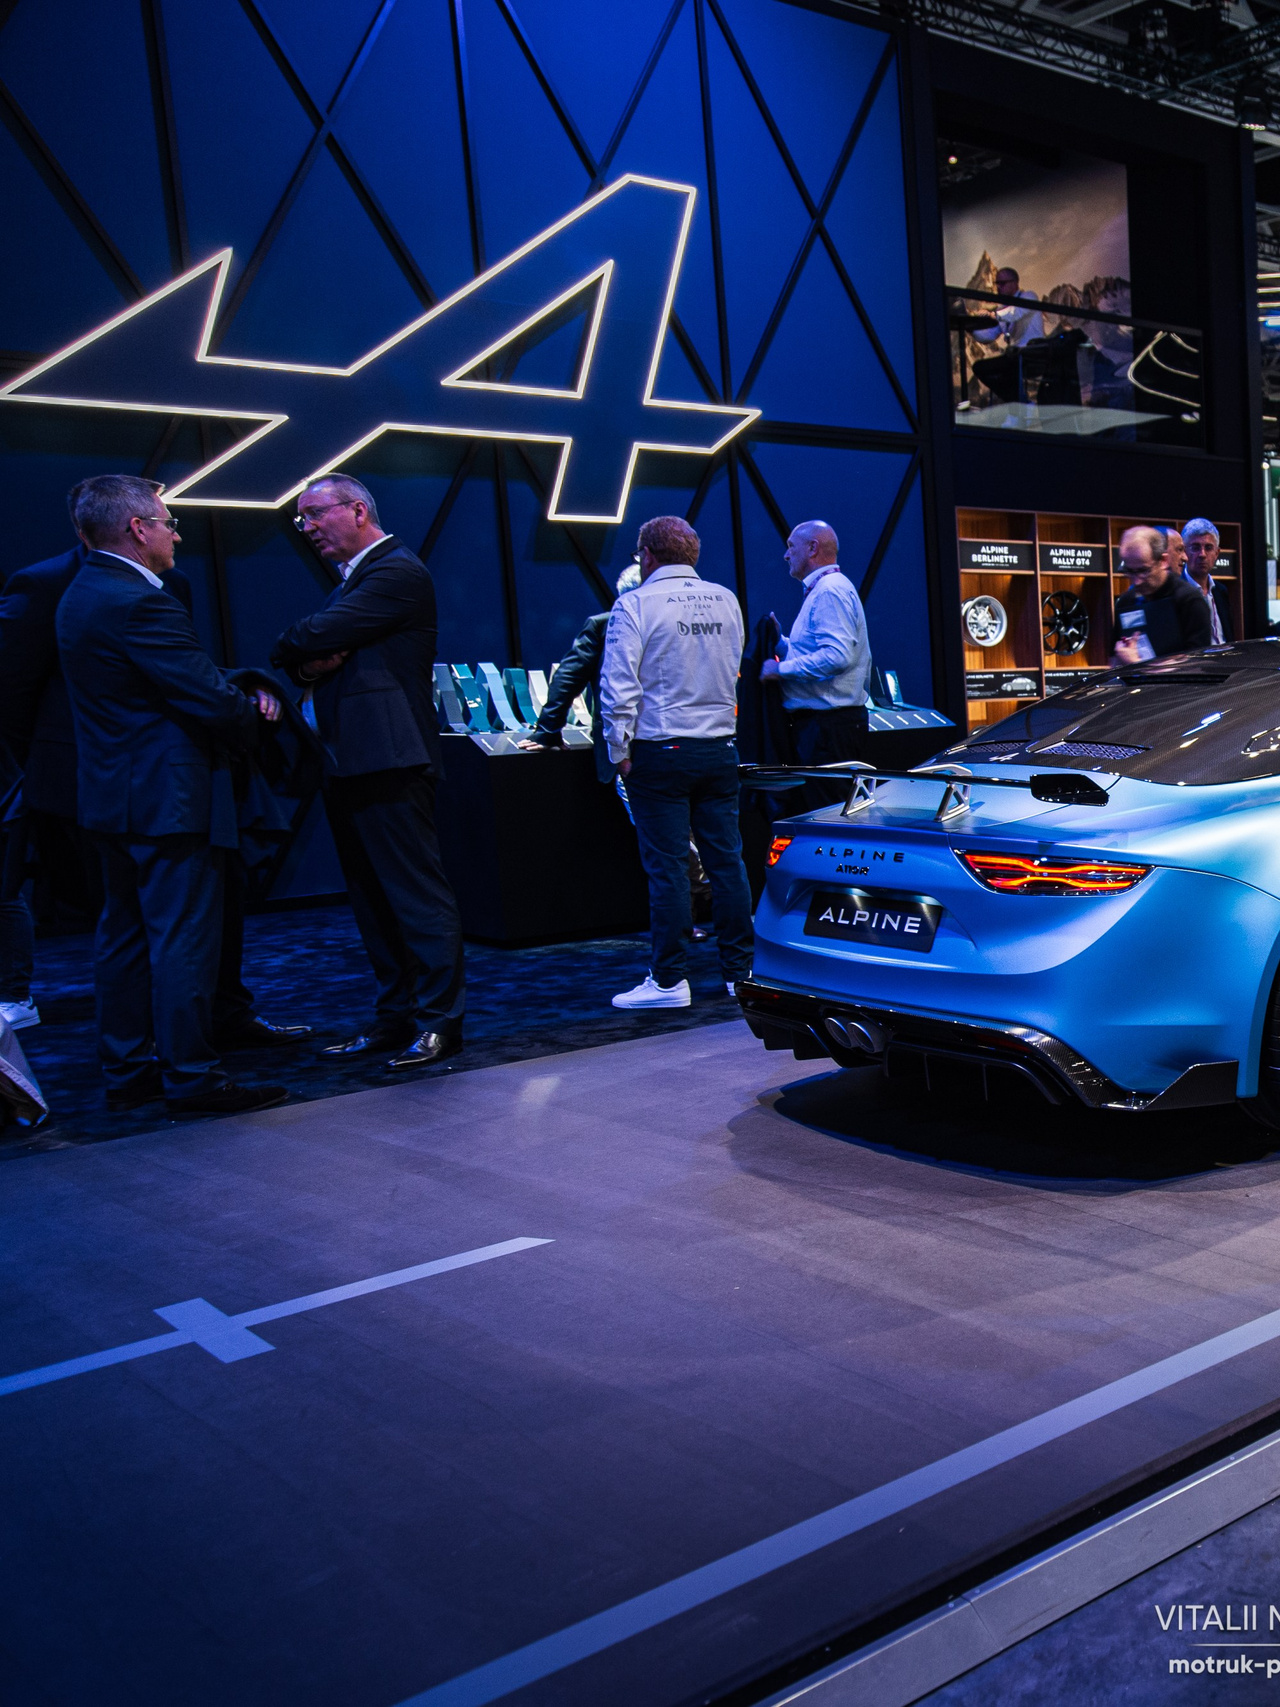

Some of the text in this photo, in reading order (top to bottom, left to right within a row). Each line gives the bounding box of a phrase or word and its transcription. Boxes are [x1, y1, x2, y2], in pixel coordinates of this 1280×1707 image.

[980, 546, 1009, 555] ALPINE
[1049, 548, 1076, 558] ALPINE
[971, 554, 1018, 564] BERLINETTE
[1052, 556, 1090, 566] RALLY GT4
[666, 595, 724, 604] ALPINE
[691, 622, 723, 635] BWT
[815, 846, 905, 863] ALPINE
[819, 906, 922, 934] ALPINE
